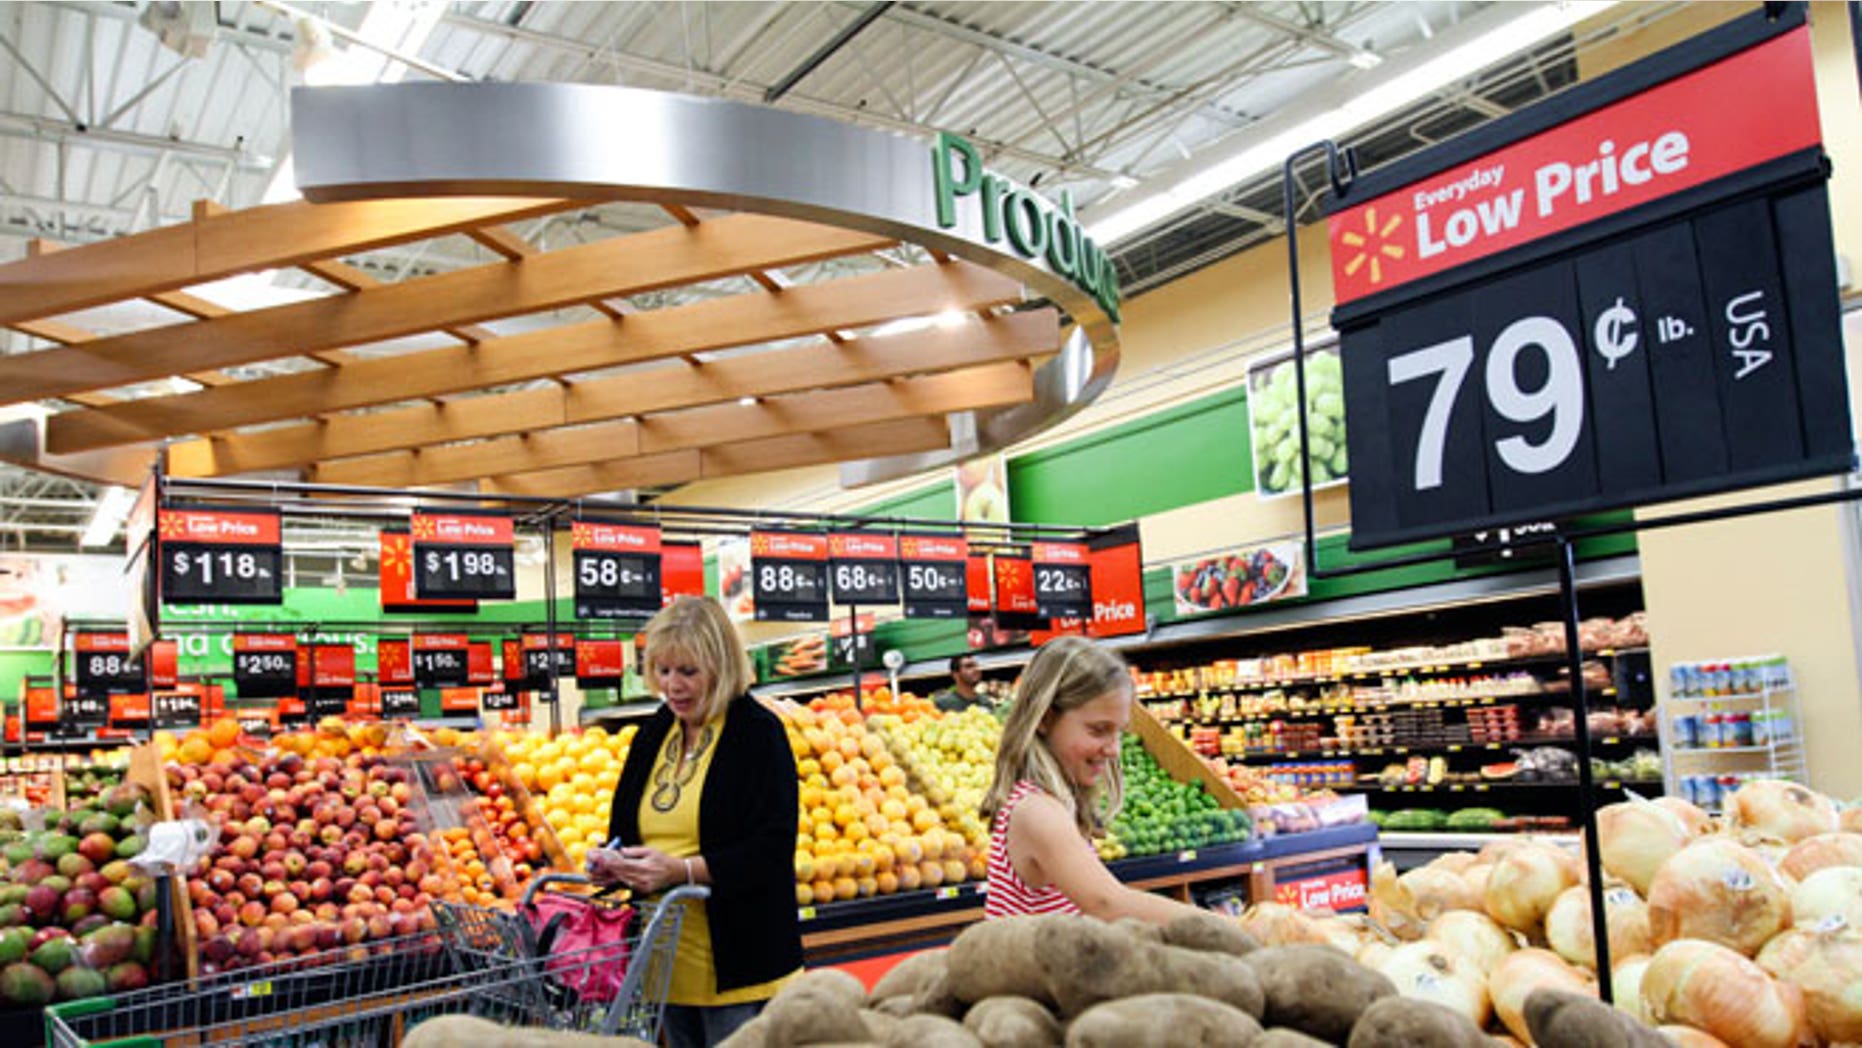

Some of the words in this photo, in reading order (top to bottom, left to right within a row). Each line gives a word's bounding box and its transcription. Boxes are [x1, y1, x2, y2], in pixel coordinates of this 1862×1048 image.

[1413, 164, 1505, 210] Everyday
[1415, 189, 1525, 259] Low
[1534, 131, 1690, 218] Price
[1657, 315, 1695, 344] lb.
[1725, 290, 1773, 380] USA
[187, 518, 218, 534] Low
[221, 521, 258, 535] Price
[1094, 599, 1136, 623] Price
